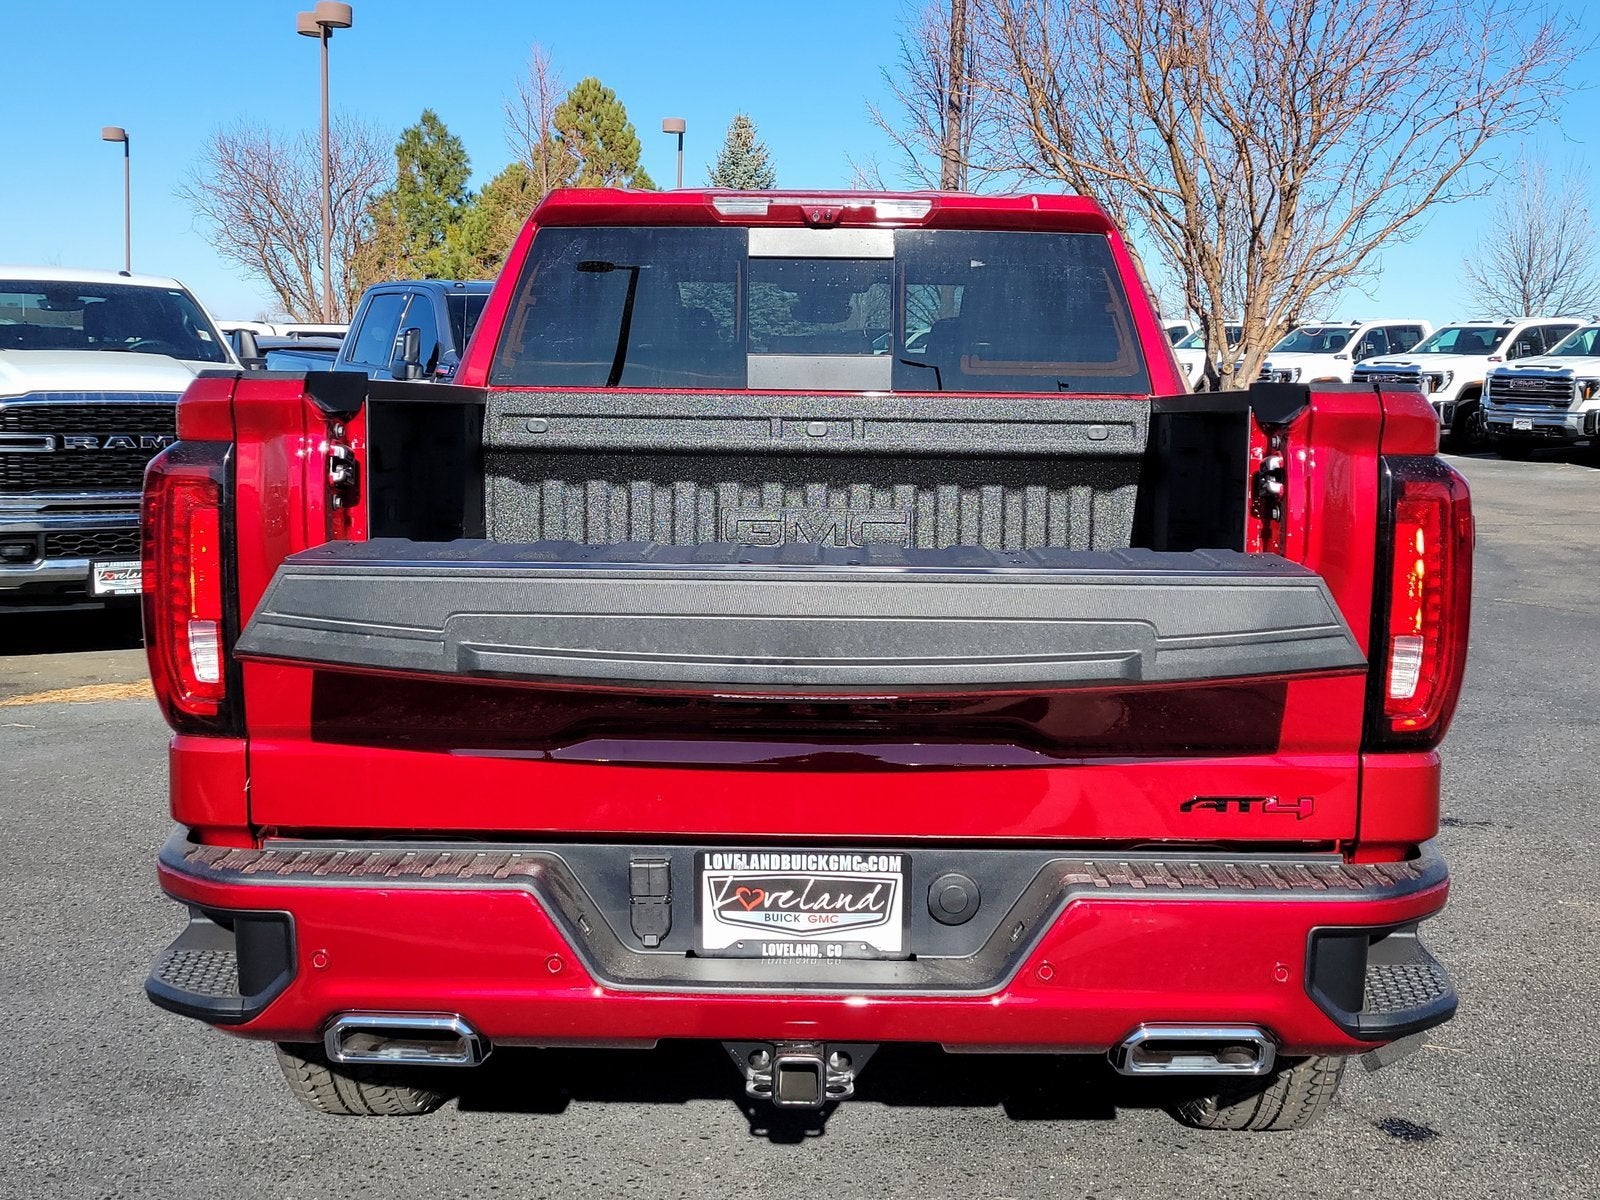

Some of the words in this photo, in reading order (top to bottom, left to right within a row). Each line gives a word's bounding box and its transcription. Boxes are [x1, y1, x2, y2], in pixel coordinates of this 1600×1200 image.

[64, 435, 174, 449] RAM
[725, 511, 907, 547] GMC
[1180, 796, 1314, 820] AT4
[704, 853, 901, 872] LOVELANDBUICKGMC.COM
[713, 875, 885, 911] Loveland
[764, 913, 800, 923] BUICK
[808, 914, 839, 924] GMC
[762, 943, 822, 957] LOVELAND,
[827, 944, 842, 957] CO
